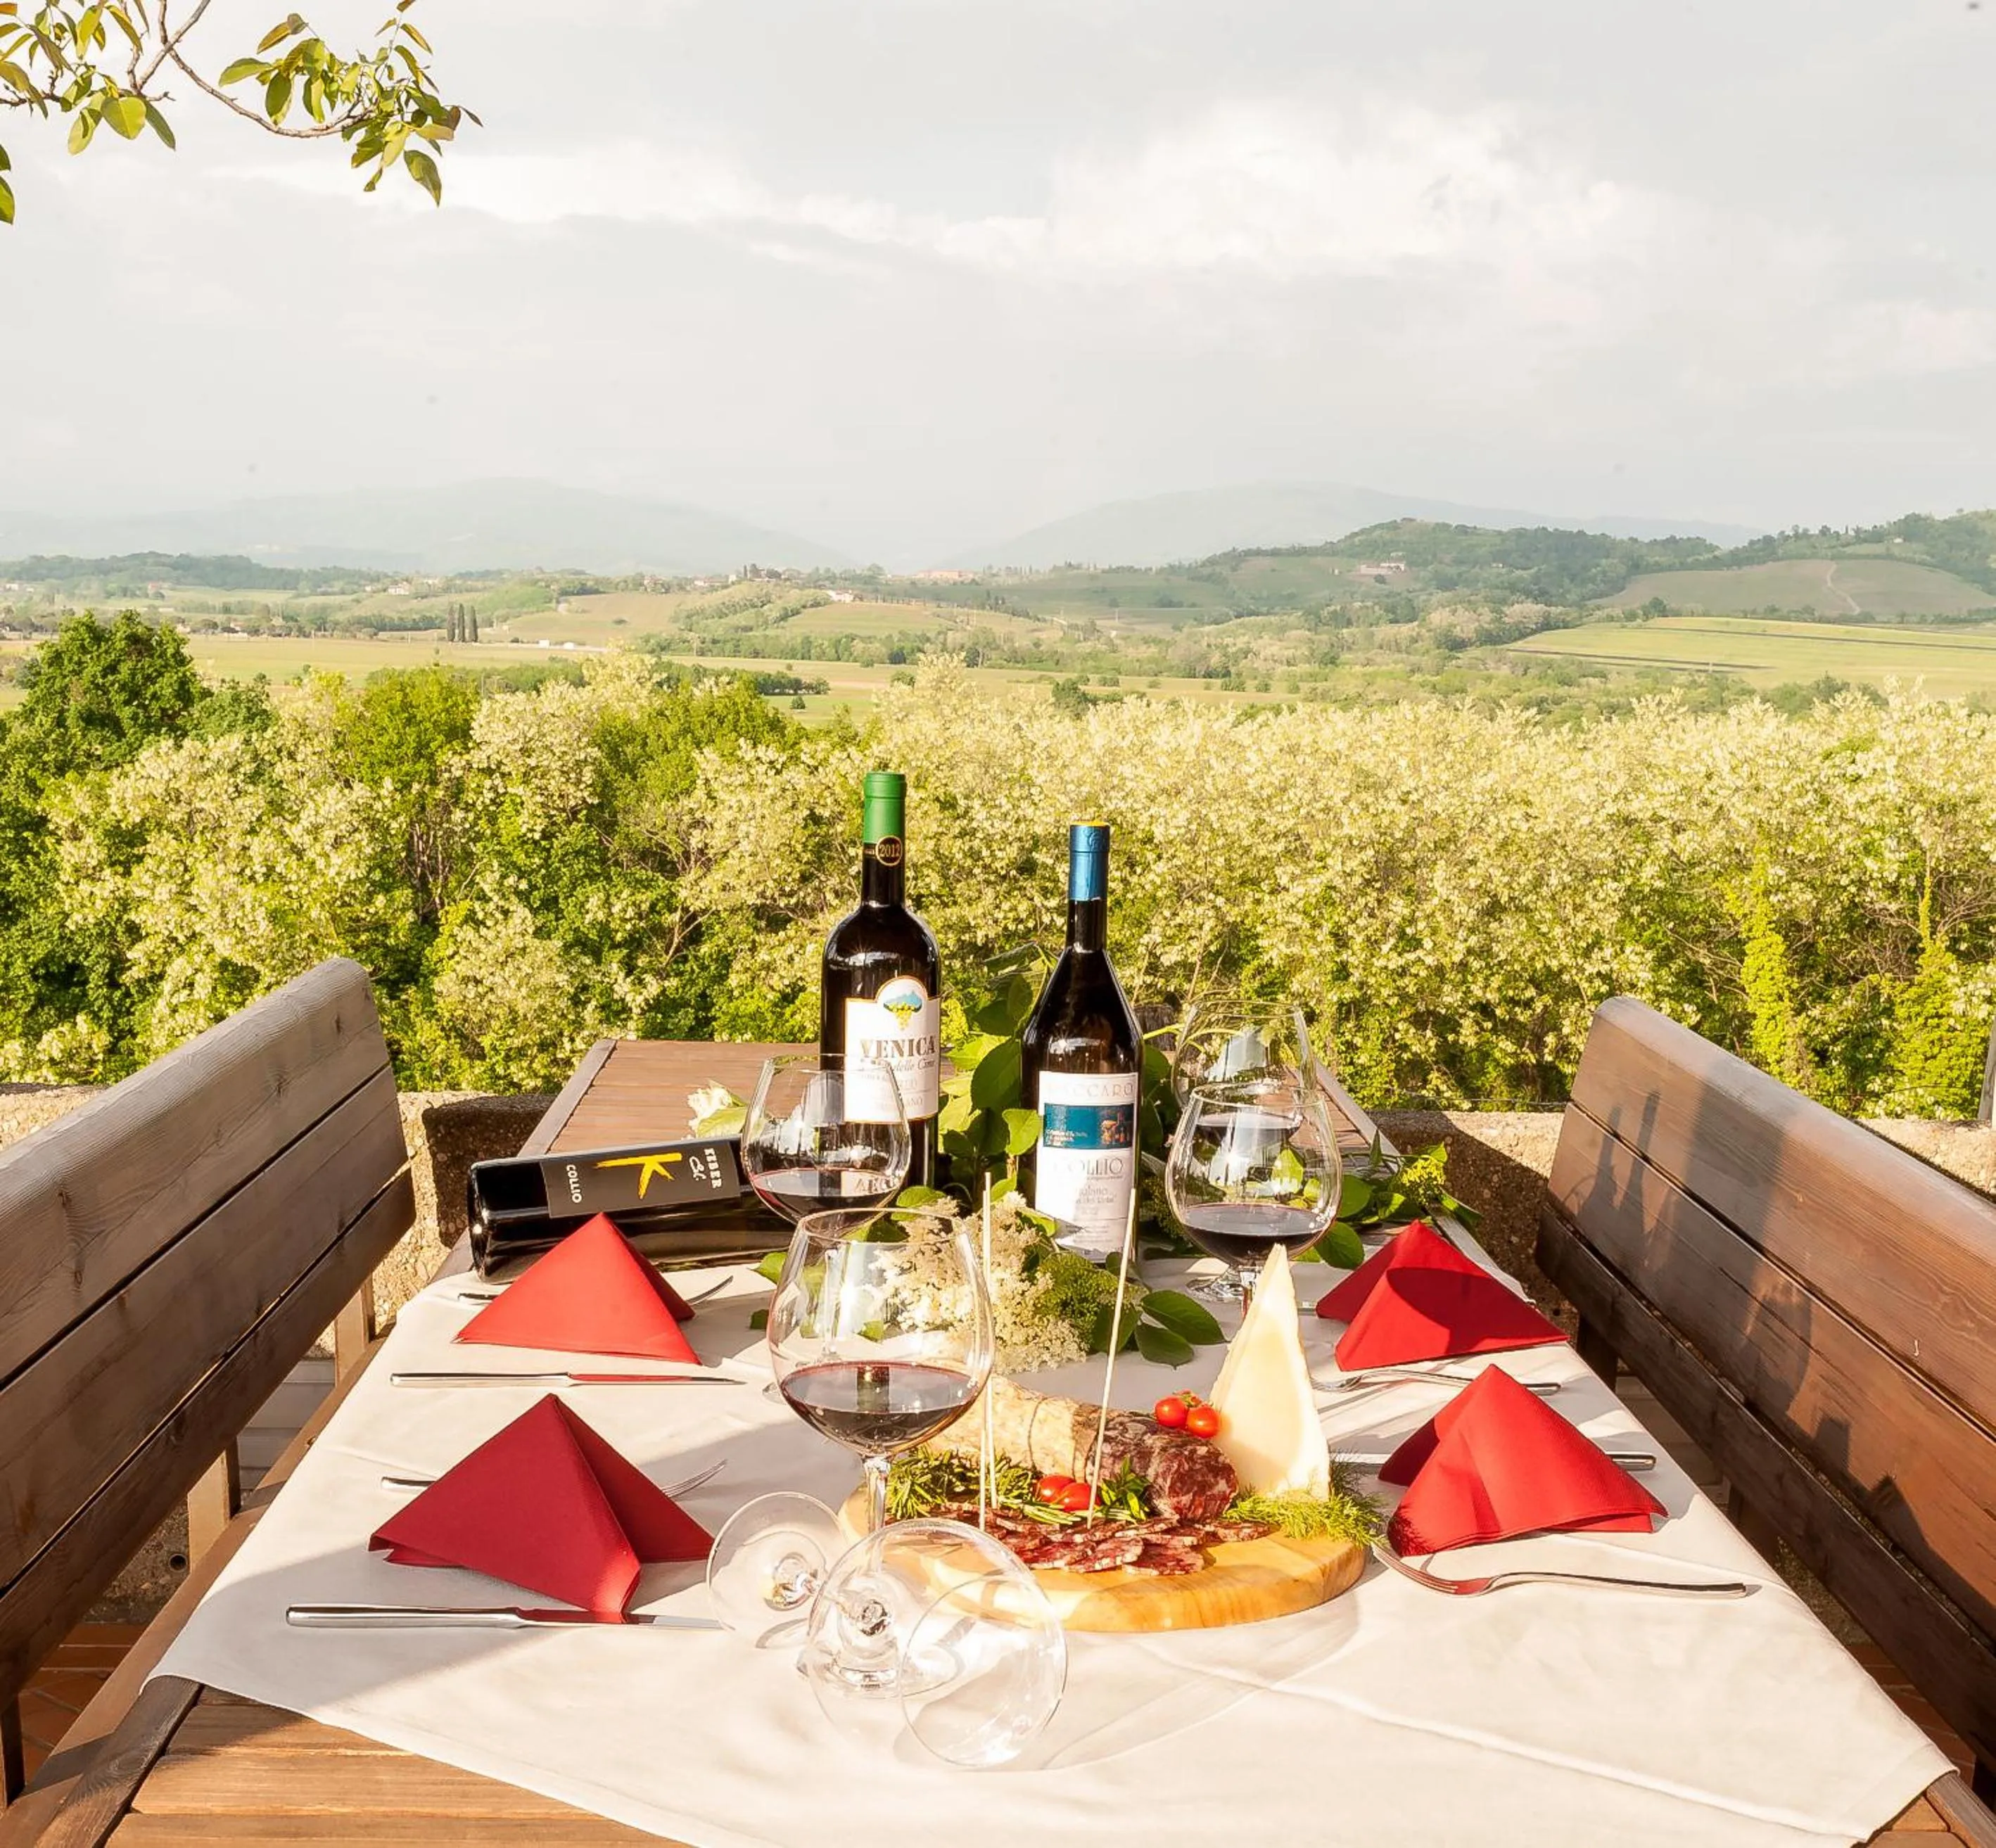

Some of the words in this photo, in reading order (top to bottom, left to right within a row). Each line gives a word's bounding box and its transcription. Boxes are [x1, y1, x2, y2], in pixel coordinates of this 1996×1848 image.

[860, 1035, 936, 1059] VENICA
[1048, 1082, 1135, 1098] CCARO
[704, 1147, 722, 1189] KEBER
[1053, 1156, 1124, 1175] OLLIO
[566, 1164, 583, 1204] COLLIO
